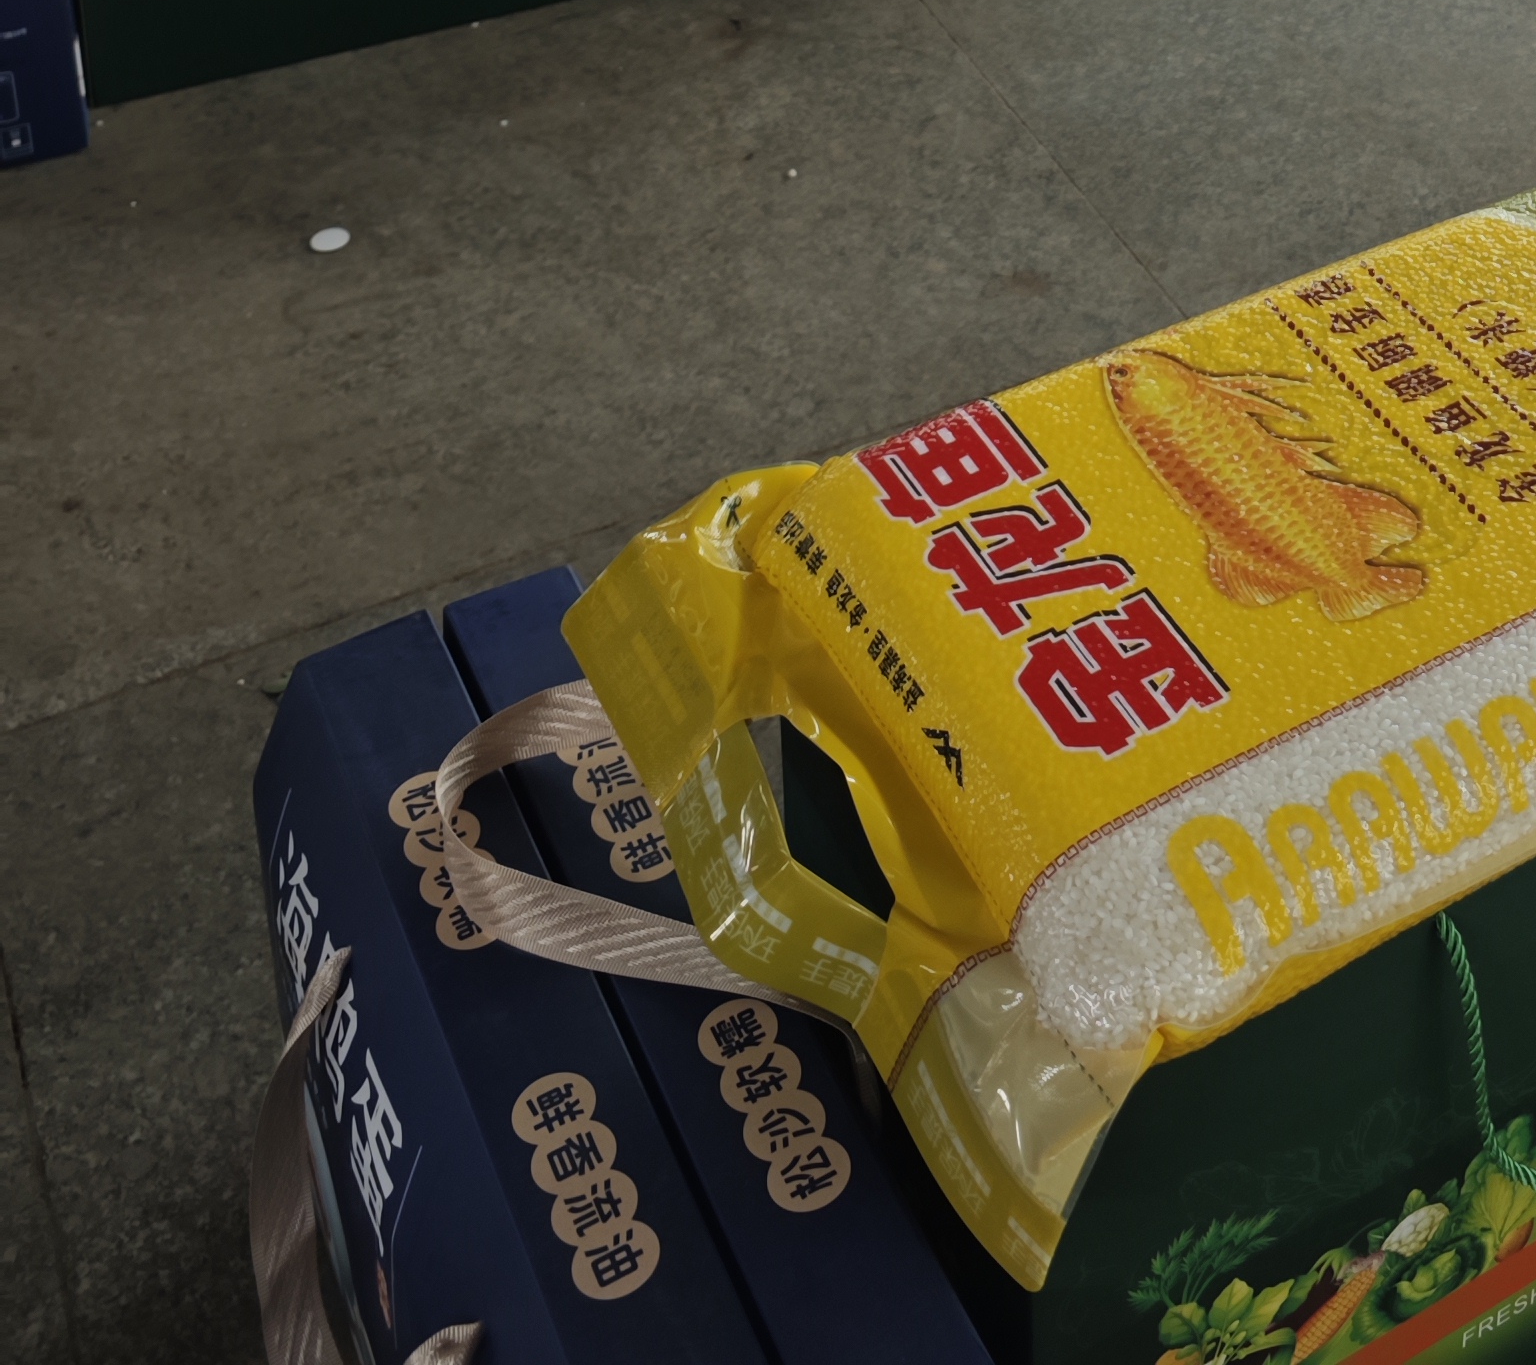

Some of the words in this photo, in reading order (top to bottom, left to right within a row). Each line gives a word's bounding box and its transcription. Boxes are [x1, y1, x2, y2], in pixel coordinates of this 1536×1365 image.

[854, 399, 1231, 759] 金龙鱼
[577, 737, 672, 874] 鲜香流
[525, 1081, 644, 1290] 鲜香流油
[710, 1006, 838, 1202] 松沙软糯
